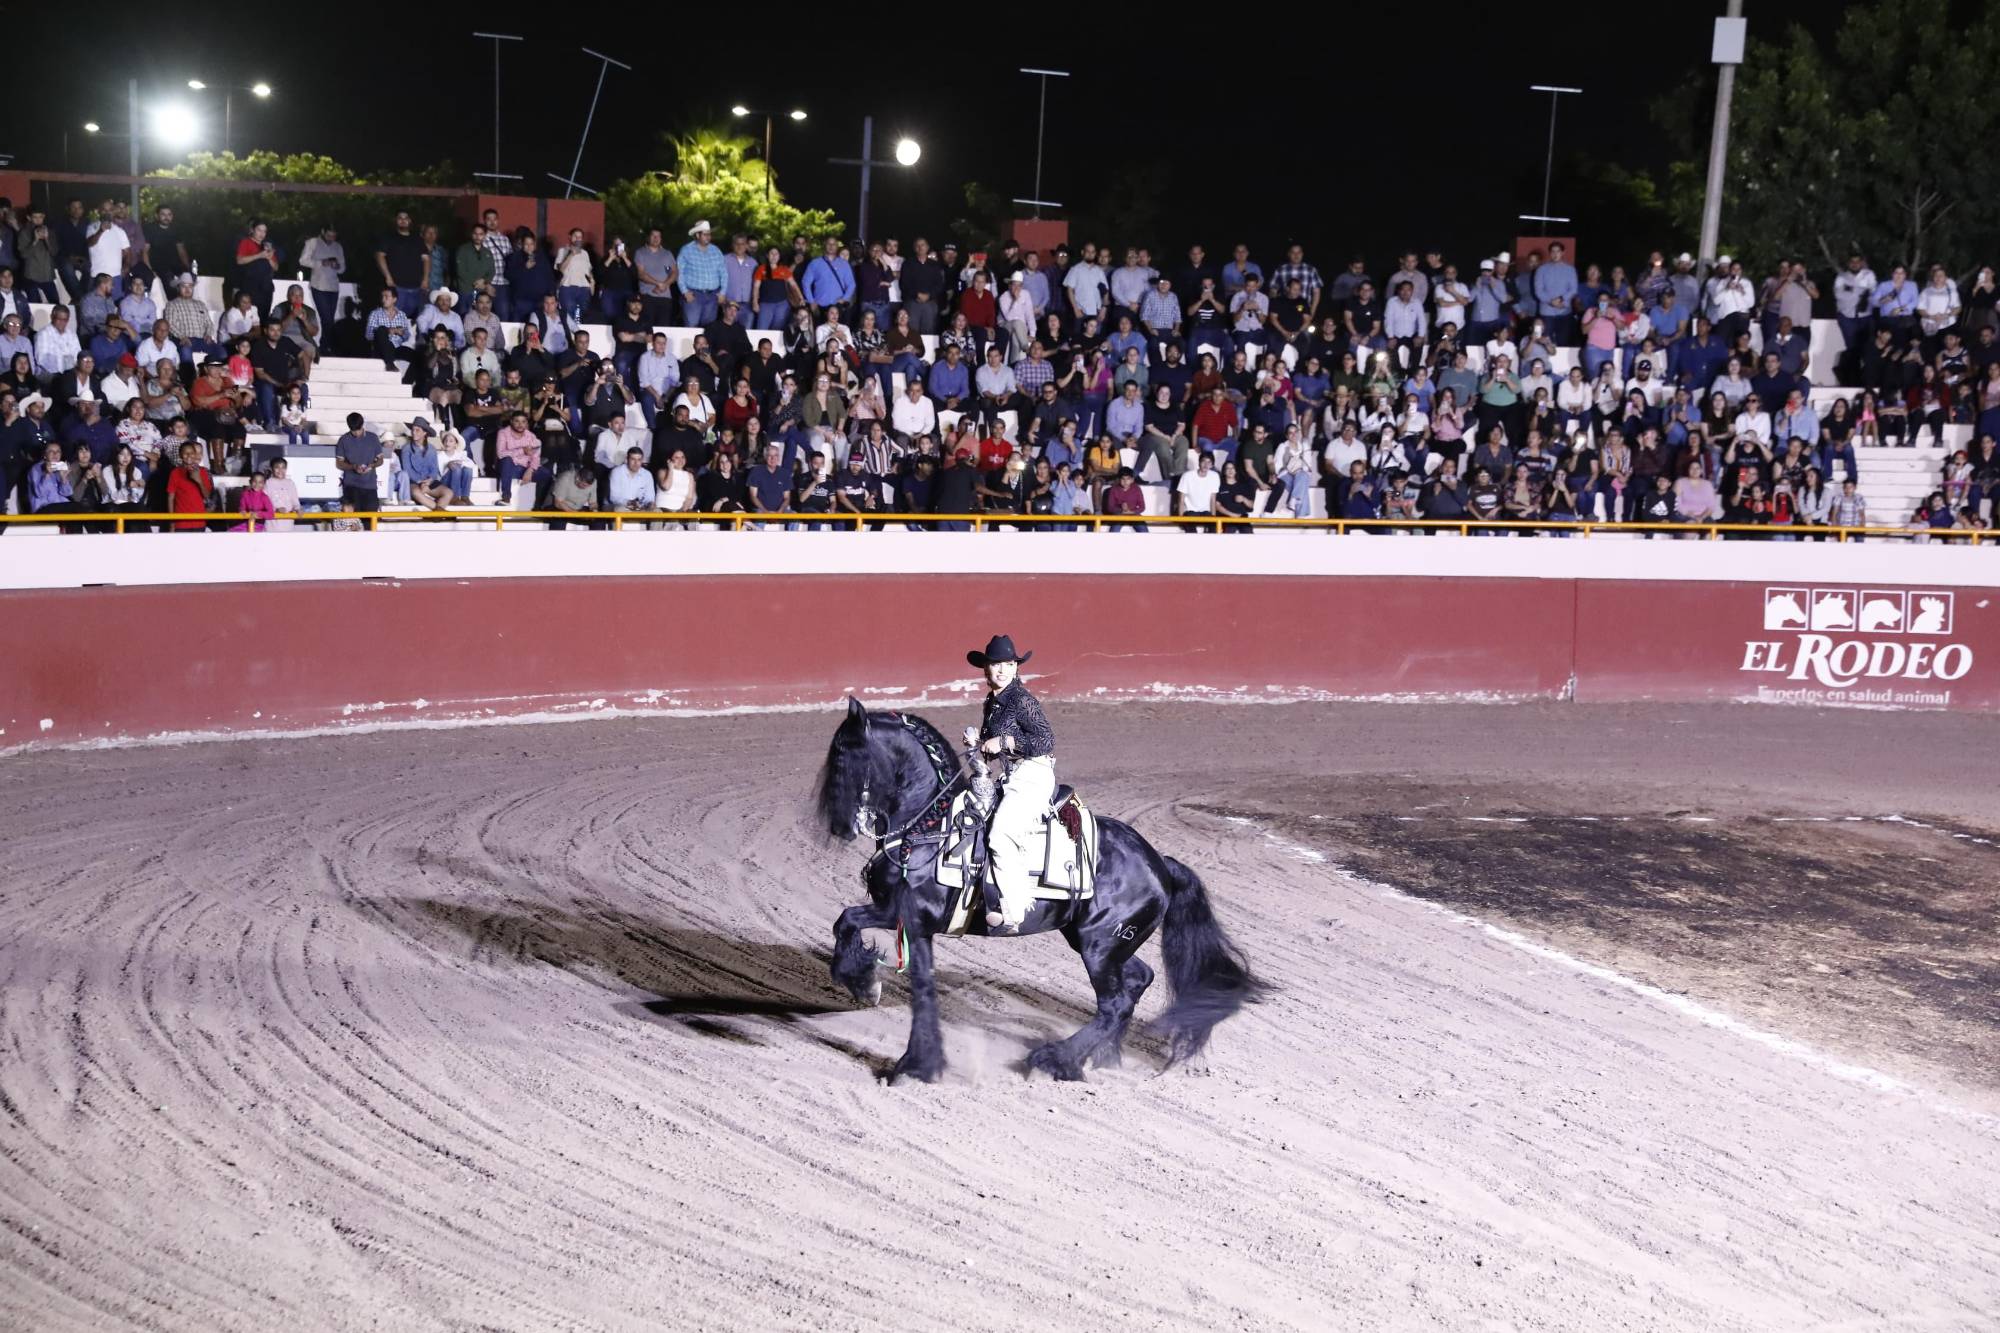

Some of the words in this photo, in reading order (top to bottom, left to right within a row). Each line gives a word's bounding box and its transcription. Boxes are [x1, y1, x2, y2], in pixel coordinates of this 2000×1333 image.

[1739, 641, 1787, 672] EL
[1786, 634, 1974, 688] RODEO
[1827, 691, 1846, 701] en
[1849, 689, 1891, 703] salud
[1895, 690, 1951, 705] animal
